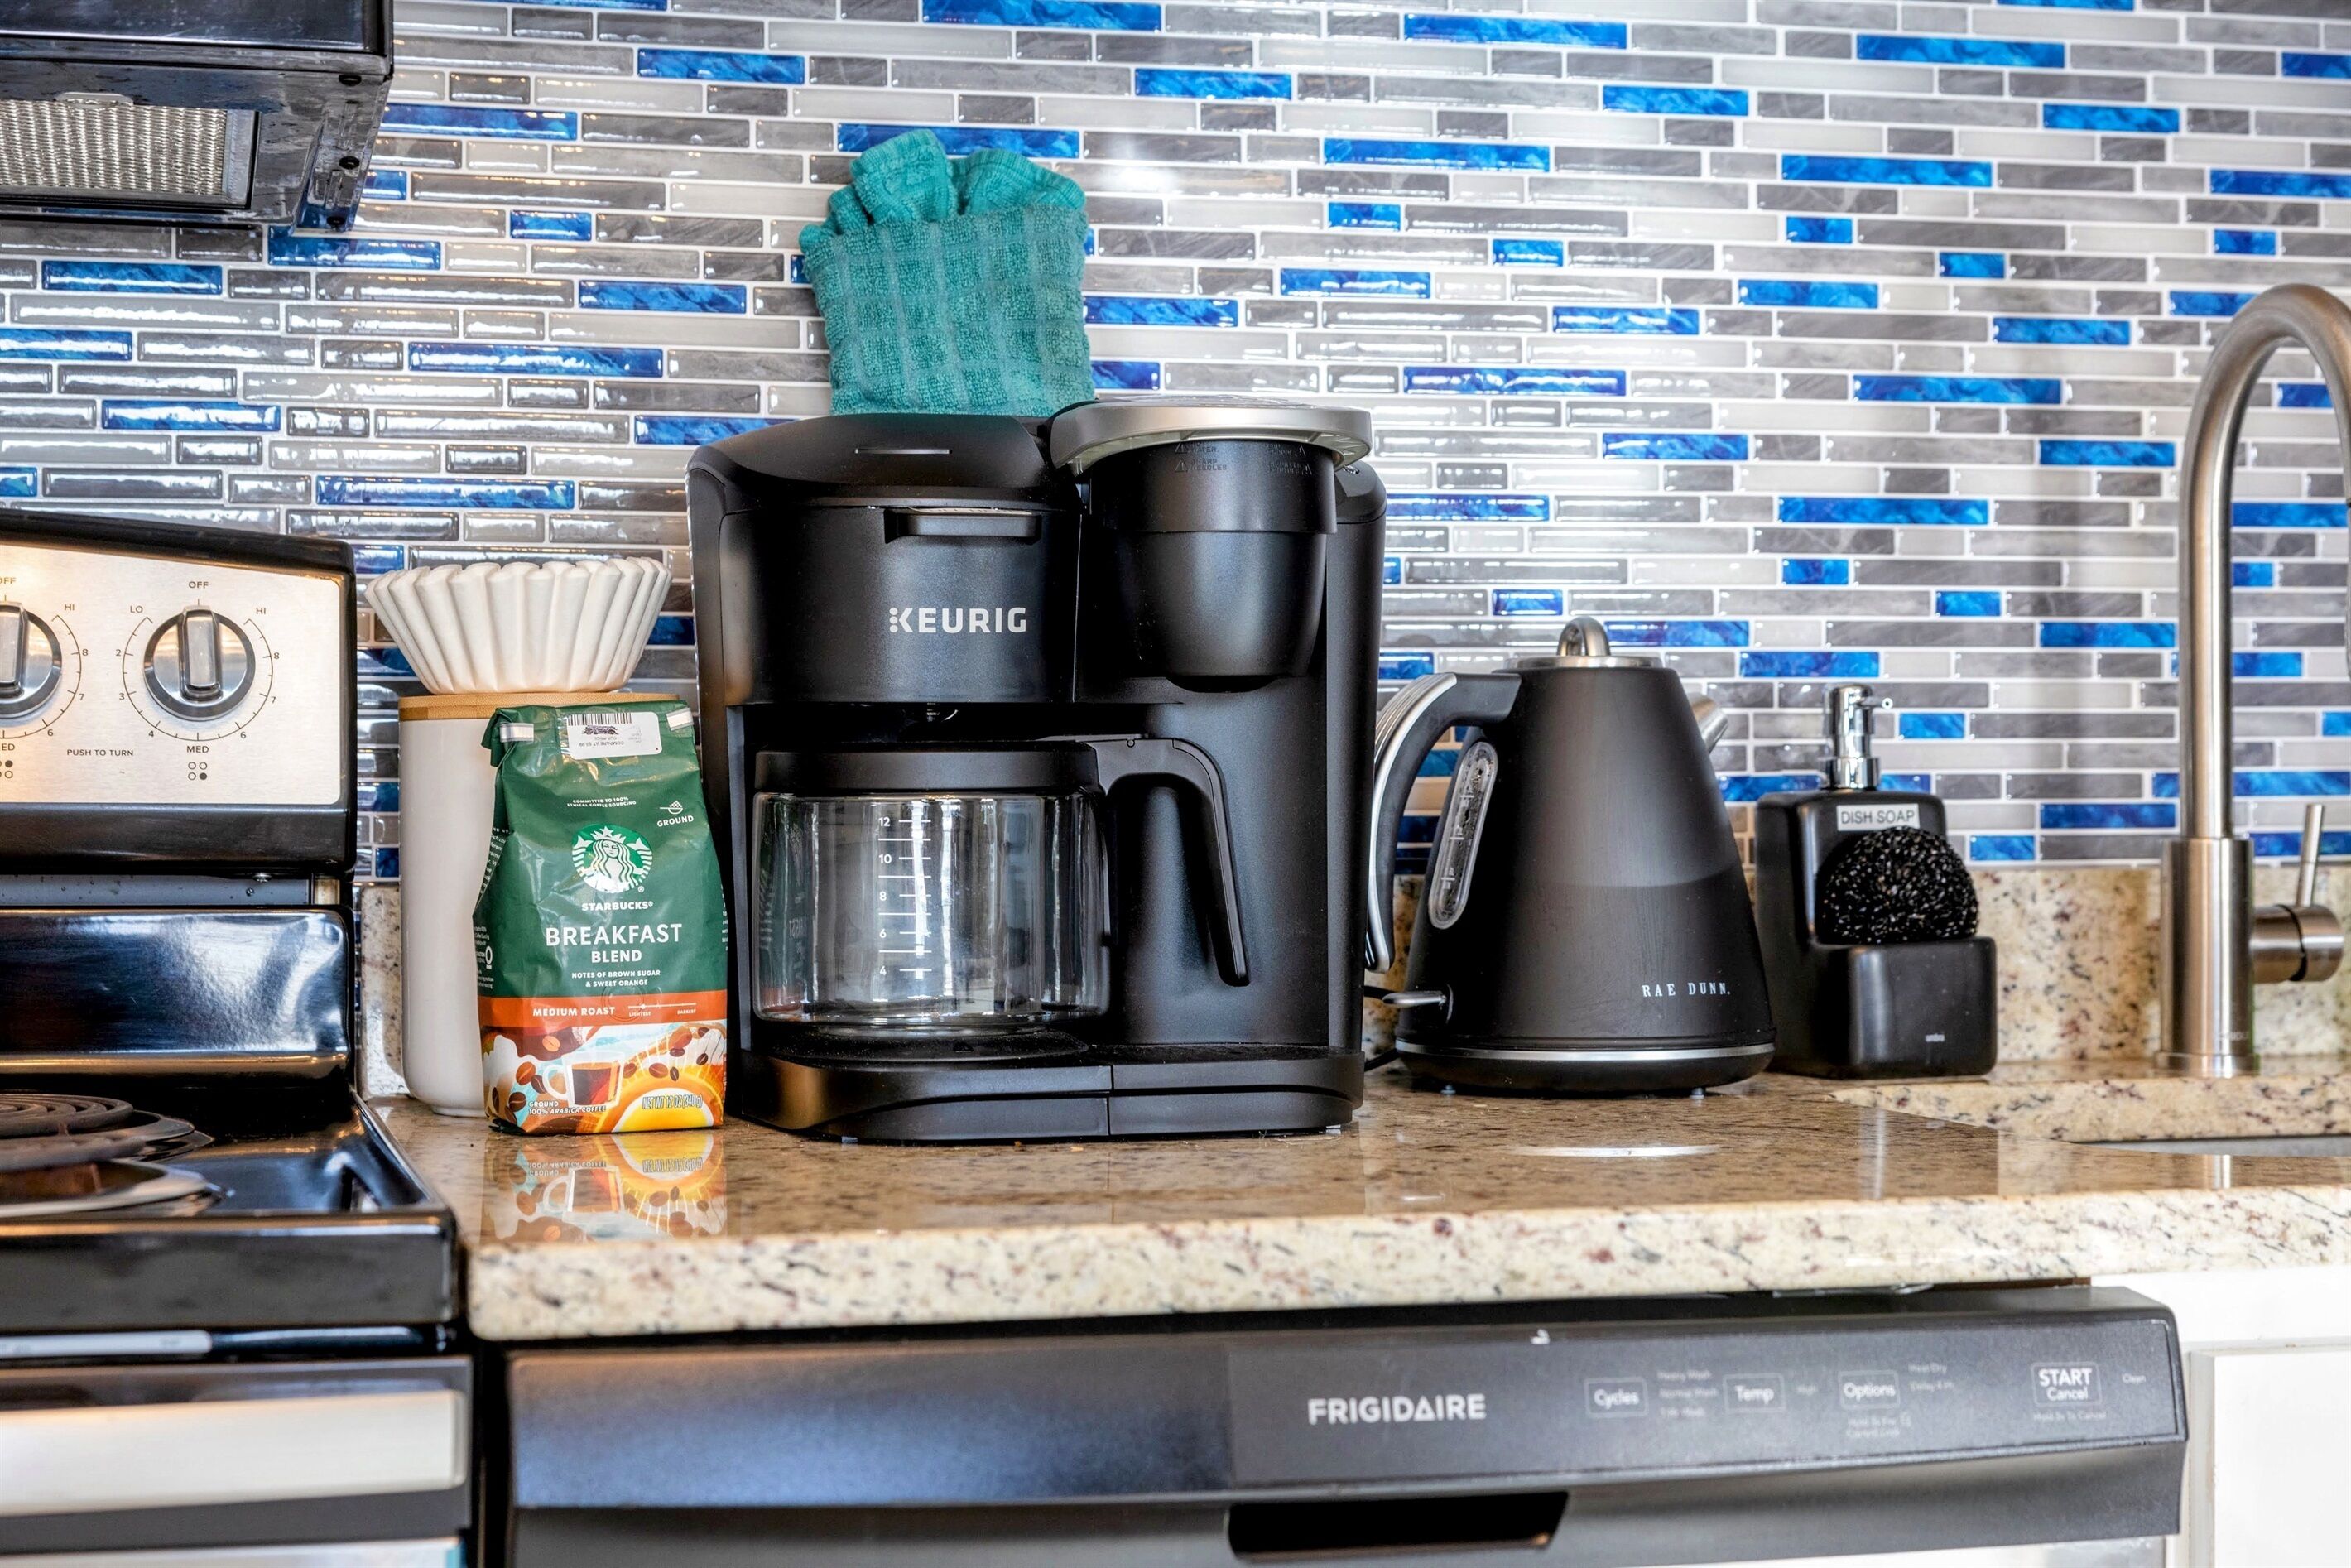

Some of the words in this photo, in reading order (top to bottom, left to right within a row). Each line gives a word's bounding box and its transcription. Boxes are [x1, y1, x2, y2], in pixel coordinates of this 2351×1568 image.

[130, 605, 143, 613] LO
[256, 607, 267, 615] HI
[889, 607, 1026, 633] KEURIG
[82, 648, 89, 657] 8
[240, 731, 247, 739] 6
[608, 800, 637, 808] SOURCING
[656, 815, 694, 827] GROUND
[878, 817, 891, 826] 12
[1841, 811, 1873, 824] DISH
[1877, 810, 1915, 823] SOAP
[878, 854, 892, 863] 10
[879, 892, 887, 901] 8
[546, 923, 682, 946] BREAKFAST
[879, 929, 887, 938] 6
[591, 950, 642, 963] BLEND
[879, 966, 887, 975] 4
[1642, 984, 1676, 997] RAE
[532, 1008, 578, 1017] MEDIUM
[581, 1006, 615, 1016] ROAST
[642, 1096, 654, 1109] NET
[655, 1095, 665, 1109] WT
[666, 1095, 673, 1109] 12
[674, 1094, 682, 1109] OZ
[2038, 1368, 2092, 1388] START
[1734, 1385, 1774, 1405] Temp
[1844, 1382, 1896, 1402] Options
[2046, 1387, 2089, 1401] Cancel
[1594, 1388, 1639, 1410] Cycles
[1307, 1393, 1487, 1426] FRIGIDAIRE
